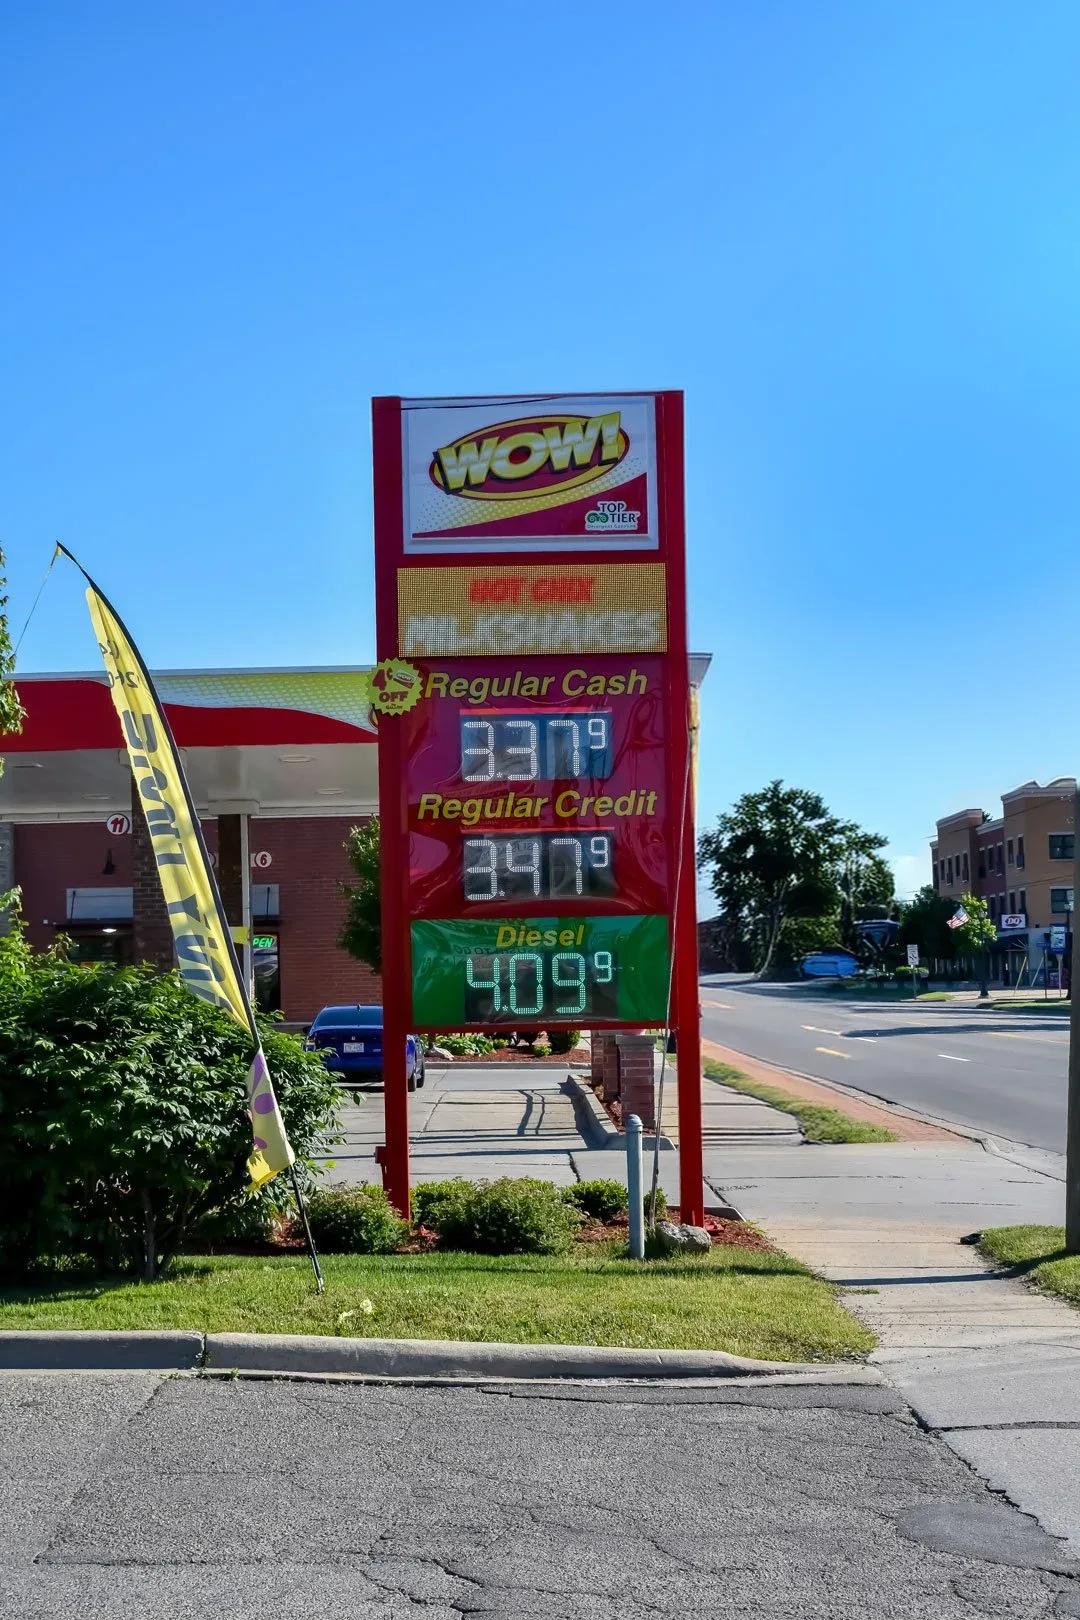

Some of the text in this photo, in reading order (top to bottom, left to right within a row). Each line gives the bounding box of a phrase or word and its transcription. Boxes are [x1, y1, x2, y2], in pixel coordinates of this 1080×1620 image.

[433, 411, 621, 495] WOW!
[600, 502, 624, 512] TOP
[610, 513, 636, 523] TIER
[404, 611, 661, 654] MILKSHAKES
[424, 668, 648, 704] Regular Cash
[379, 691, 408, 703] OFF
[417, 789, 658, 826] Regular Credit
[111, 817, 125, 832] 11
[252, 937, 273, 948] PEN
[496, 924, 584, 947] Diesel
